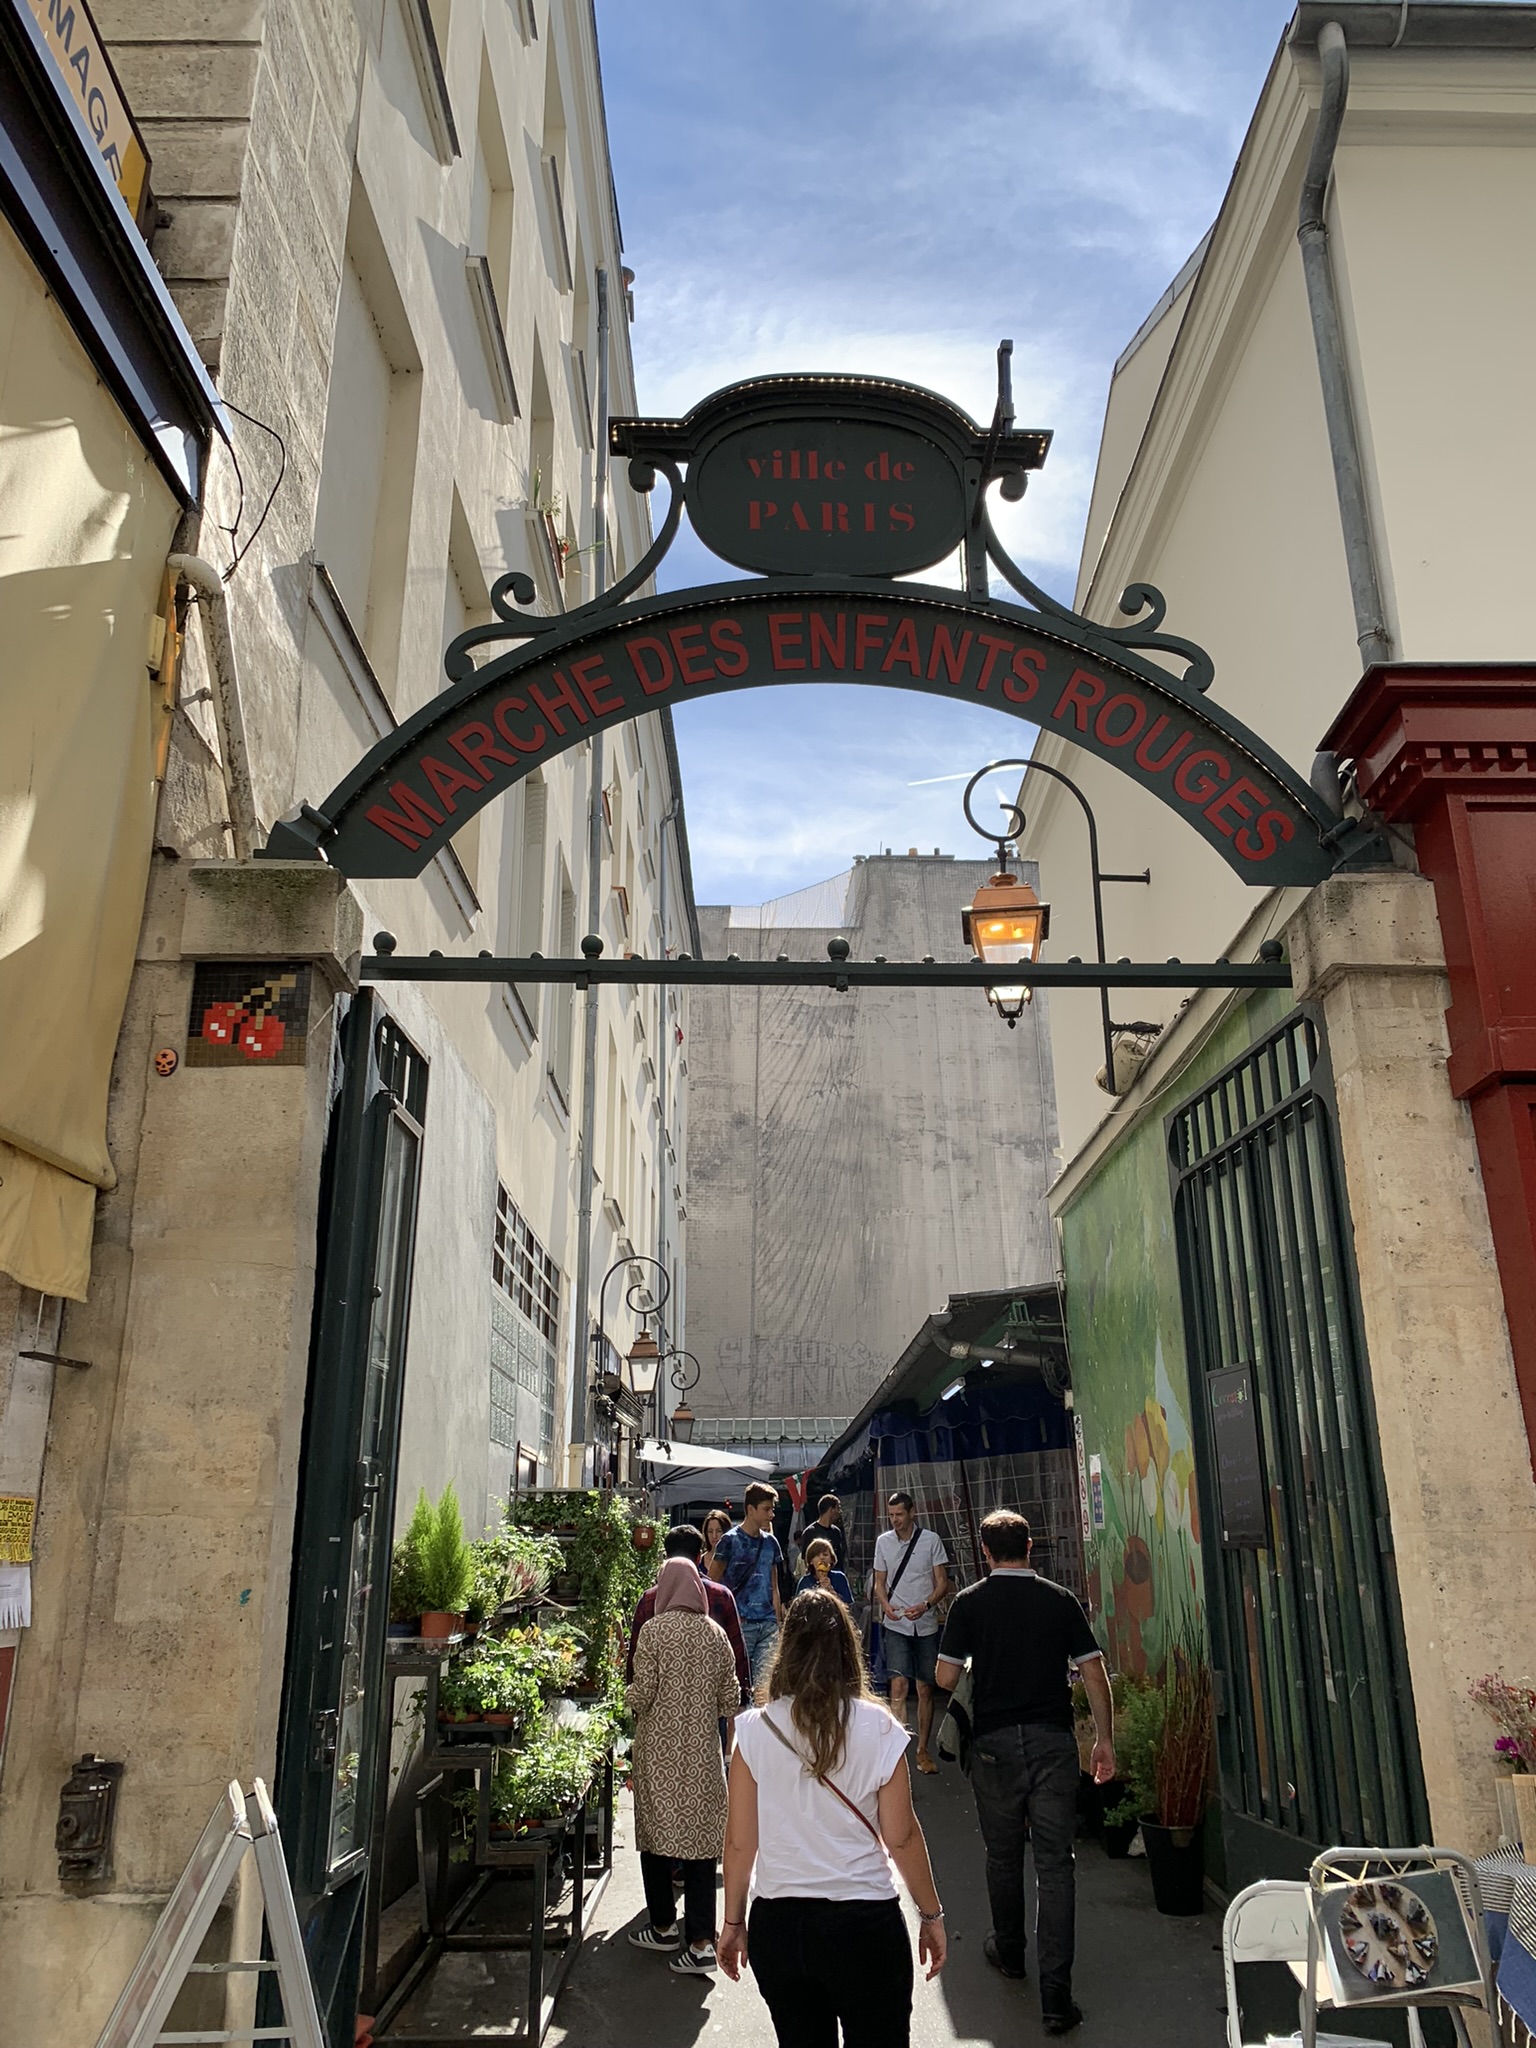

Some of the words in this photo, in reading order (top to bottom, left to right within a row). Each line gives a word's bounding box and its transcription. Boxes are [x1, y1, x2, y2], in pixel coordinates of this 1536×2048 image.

[37, 0, 122, 181] MAGE
[747, 450, 846, 481] ville
[864, 452, 916, 482] de
[748, 500, 916, 533] PARIS
[365, 654, 626, 852] MARCHE
[625, 619, 749, 697] DES
[768, 612, 1048, 704] ENFANTS
[1052, 667, 1295, 862] ROUGES
[0, 1511, 32, 1522] LEMAND
